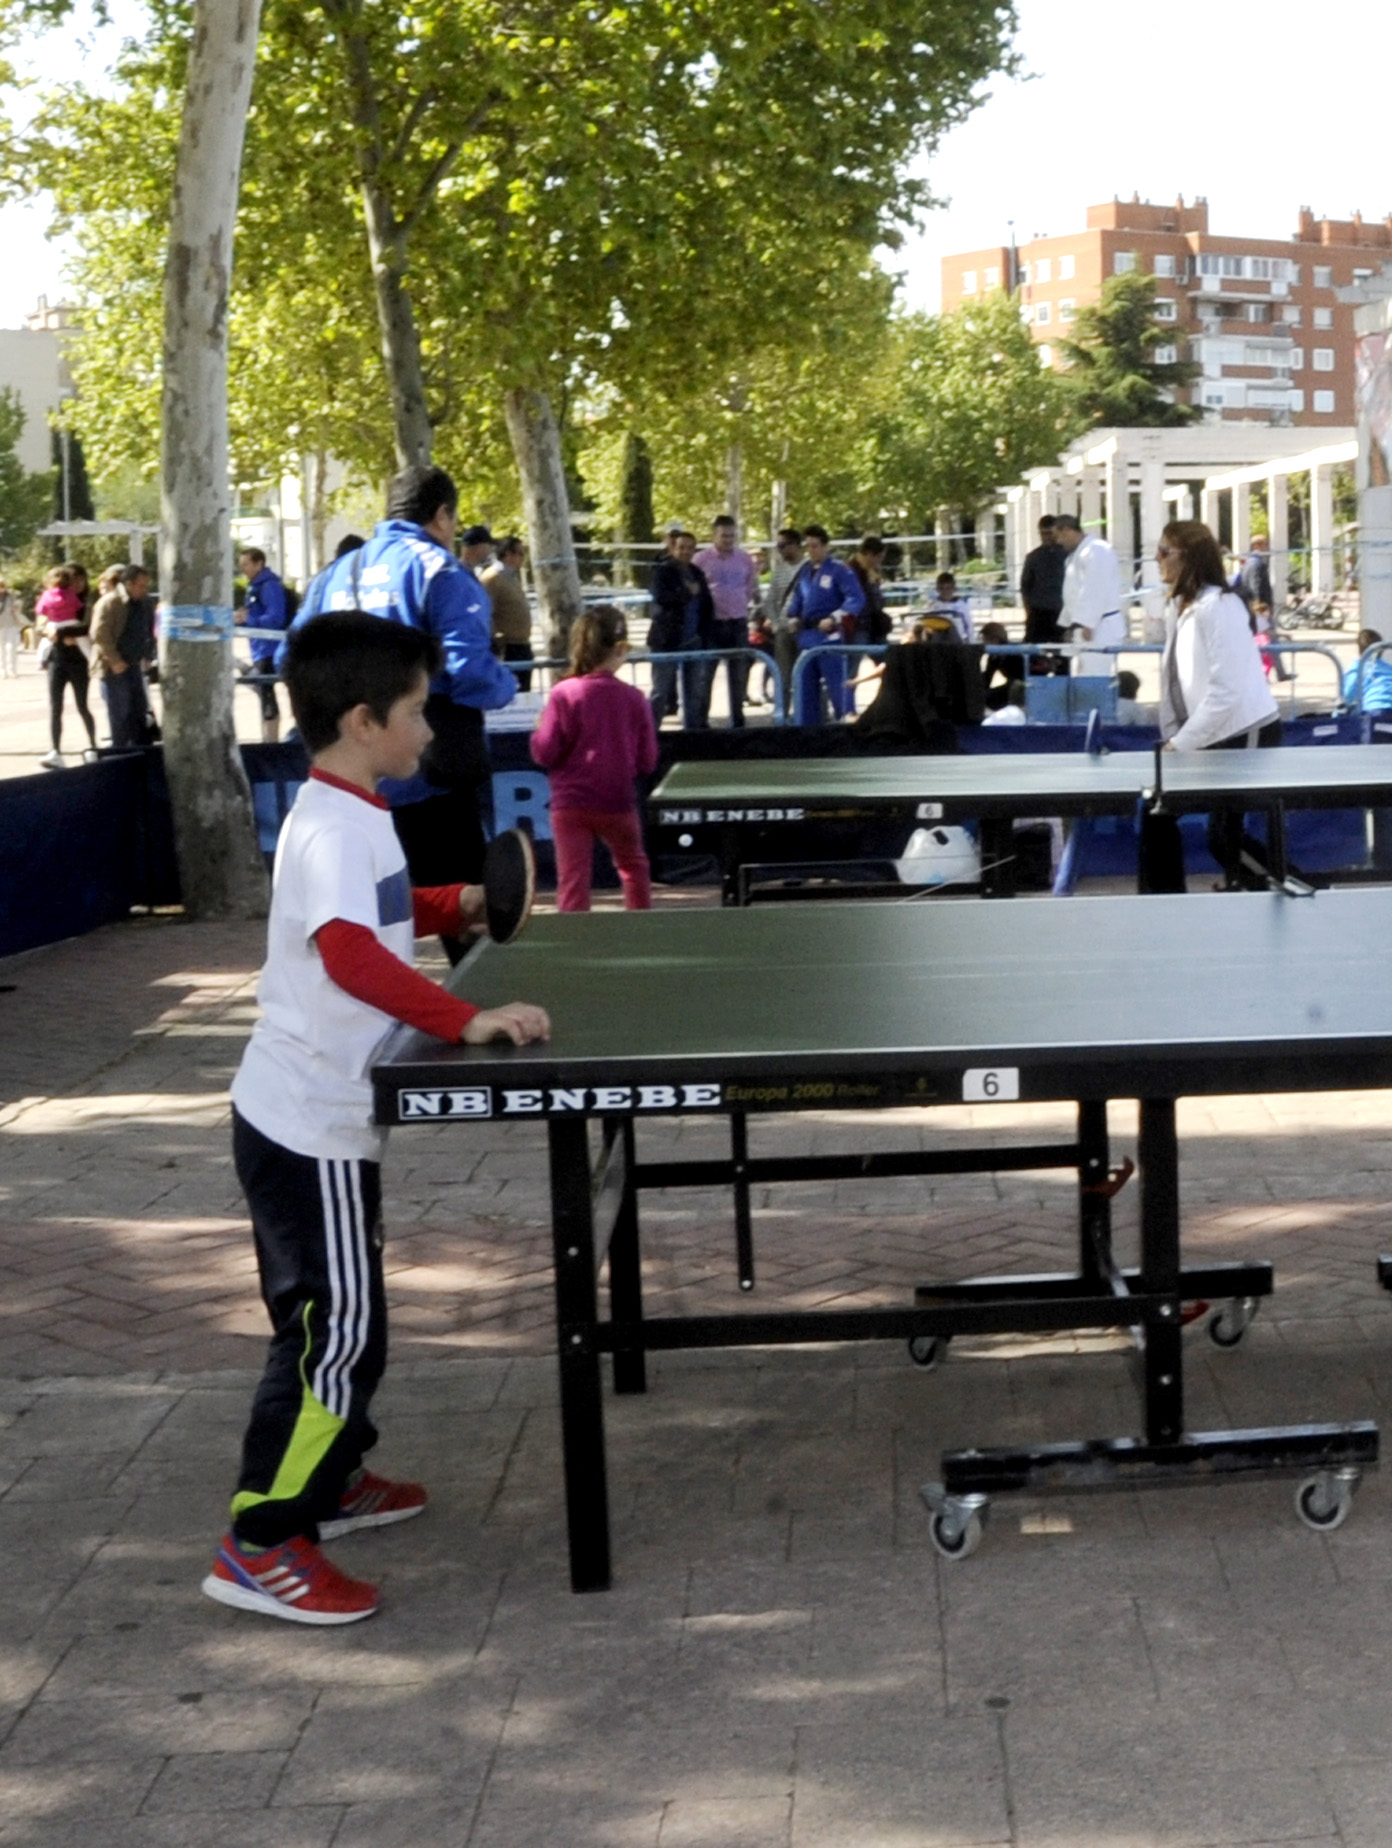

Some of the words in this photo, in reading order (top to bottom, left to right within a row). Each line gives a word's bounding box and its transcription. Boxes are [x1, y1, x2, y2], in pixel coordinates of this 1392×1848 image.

[662, 810, 701, 824] NB
[706, 808, 805, 823] ENEBE
[982, 1072, 999, 1096] 6
[404, 1091, 489, 1116] NB
[502, 1083, 721, 1113] ENEBE
[725, 1084, 788, 1100] Europa
[792, 1083, 834, 1098] 2000
